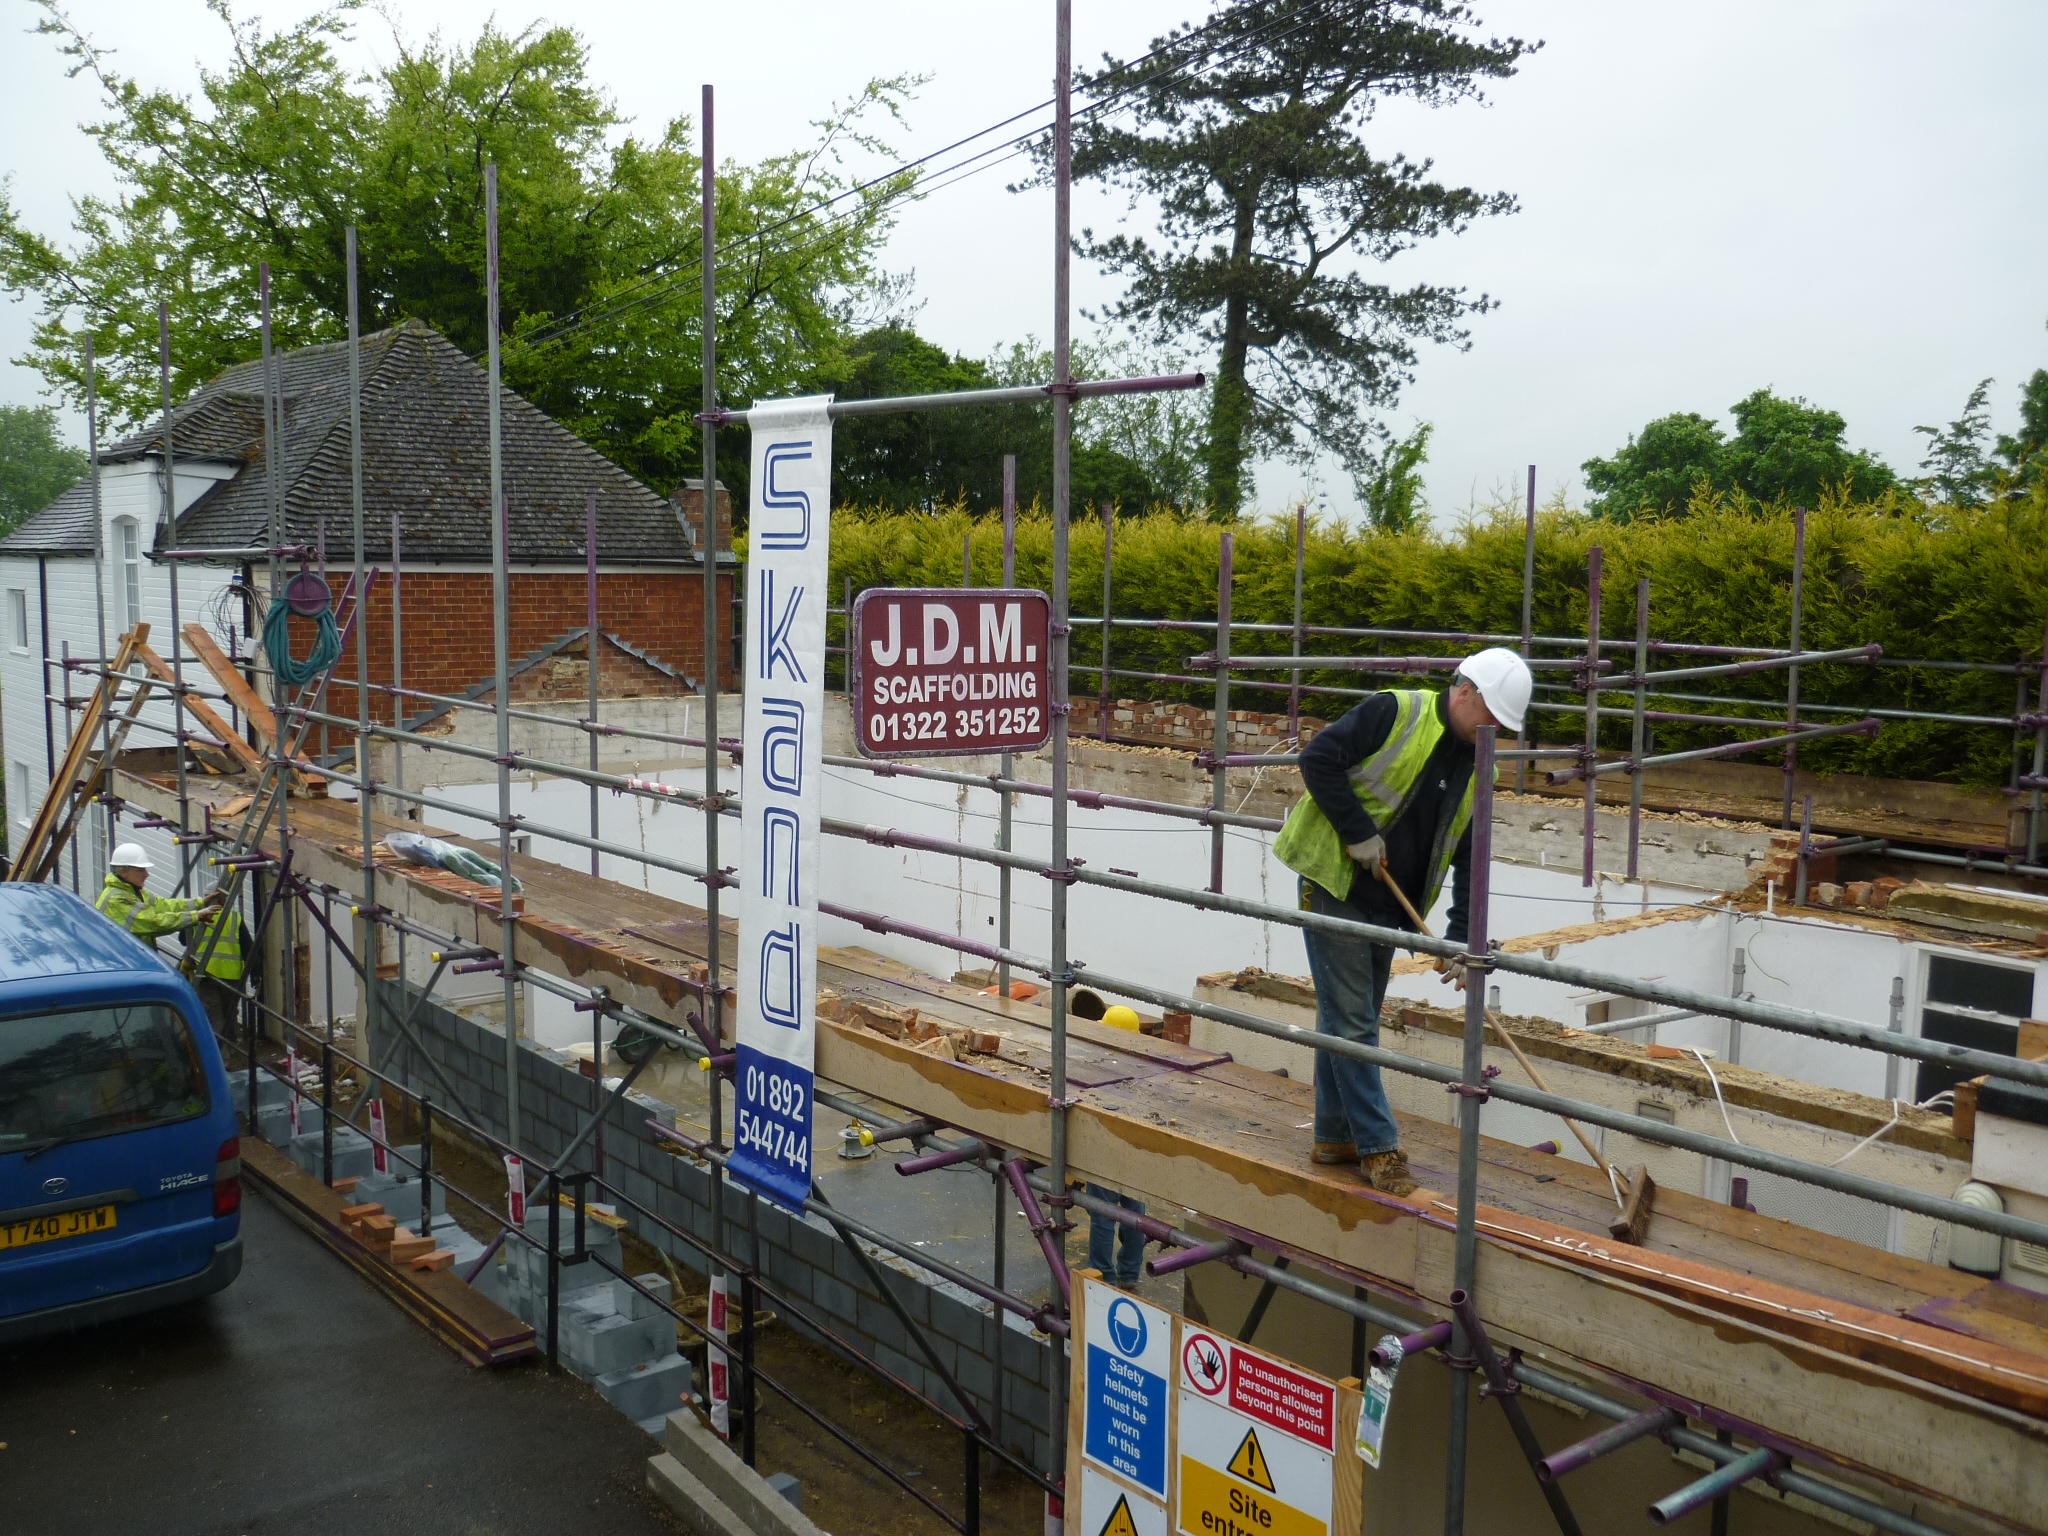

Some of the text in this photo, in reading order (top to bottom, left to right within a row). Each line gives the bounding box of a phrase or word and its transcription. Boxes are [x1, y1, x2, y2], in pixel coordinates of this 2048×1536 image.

[870, 603, 1037, 667] J.D.M.
[873, 671, 1037, 705] SCAFFOLDING
[870, 706, 1040, 743] 01322 351252
[746, 1065, 805, 1123] 01892
[739, 1108, 808, 1174] 544744
[160, 1172, 194, 1184] TOYOTA
[160, 1174, 209, 1191] HIACE
[3, 1209, 107, 1244] T740 JTW
[1109, 1358, 1144, 1387] Safety
[1238, 1358, 1324, 1404] No unauthorised
[1105, 1374, 1149, 1407] helmets
[1238, 1376, 1323, 1419] persons allowed
[1103, 1394, 1147, 1425] must be
[1236, 1387, 1325, 1437] beyond this point
[1107, 1431, 1141, 1460] in this
[1112, 1417, 1140, 1441] worn
[1112, 1455, 1137, 1477] area
[1229, 1488, 1272, 1528] Site
